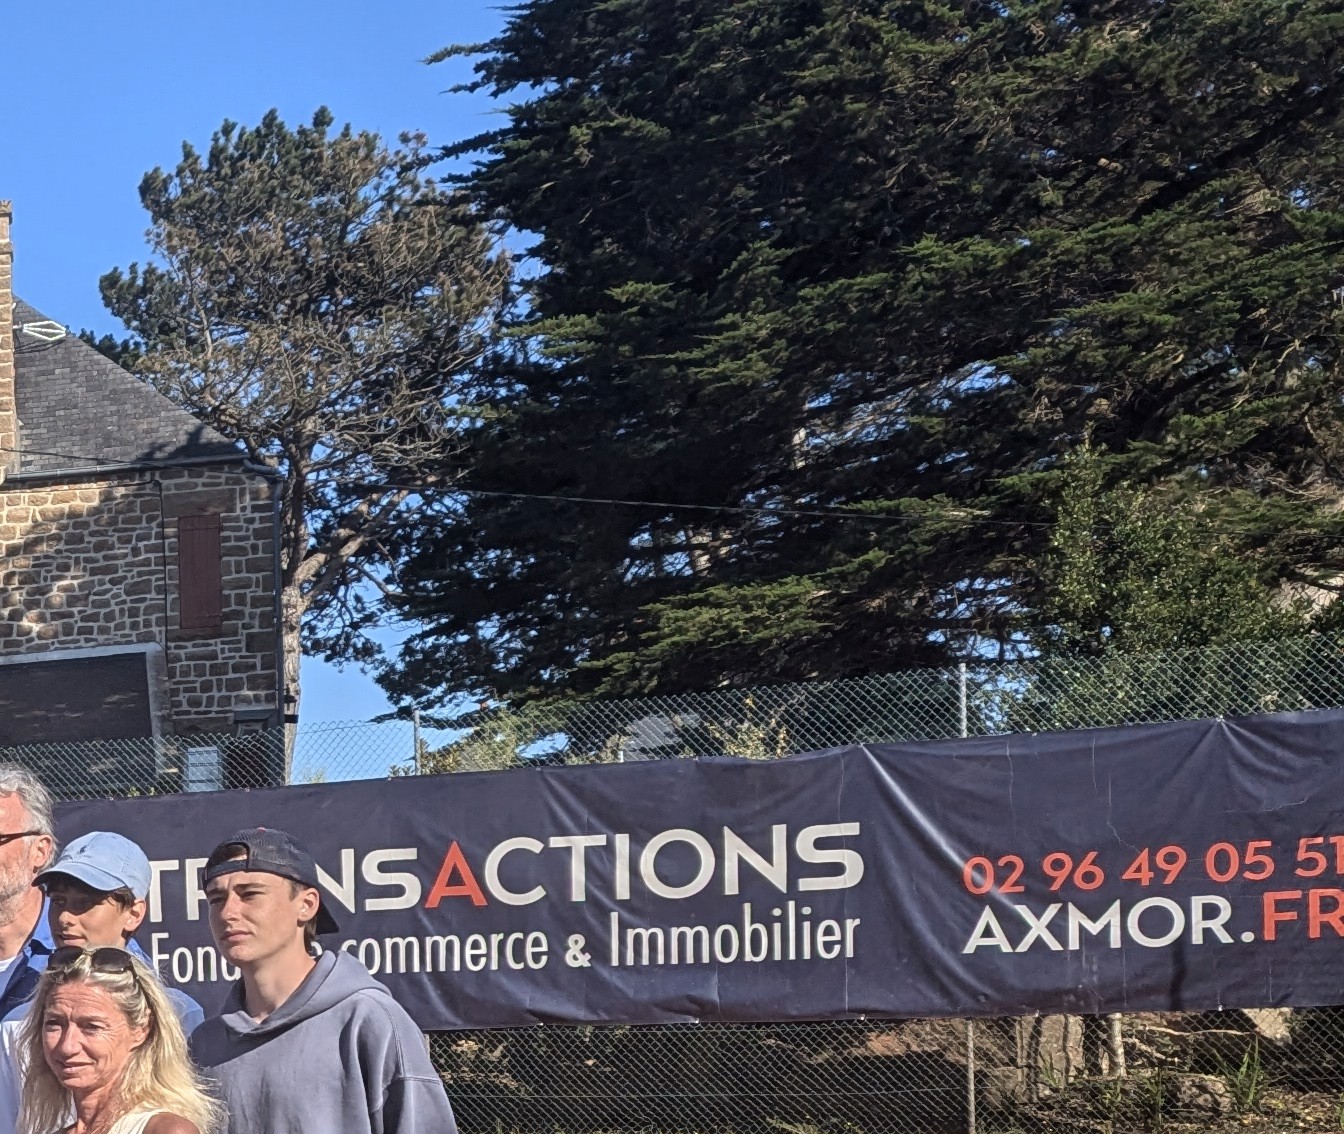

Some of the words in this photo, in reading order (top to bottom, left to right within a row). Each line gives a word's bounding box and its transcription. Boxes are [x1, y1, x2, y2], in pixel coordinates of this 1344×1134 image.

[148, 823, 864, 923] TNSACTIONS
[963, 855, 1025, 895] 02
[1042, 852, 1105, 891] 96
[1122, 845, 1187, 886] 49
[1204, 840, 1275, 882] 05
[1294, 835, 1344, 877] 51
[151, 932, 242, 984] Fon
[565, 933, 592, 968] &
[610, 900, 861, 968] Immobilier
